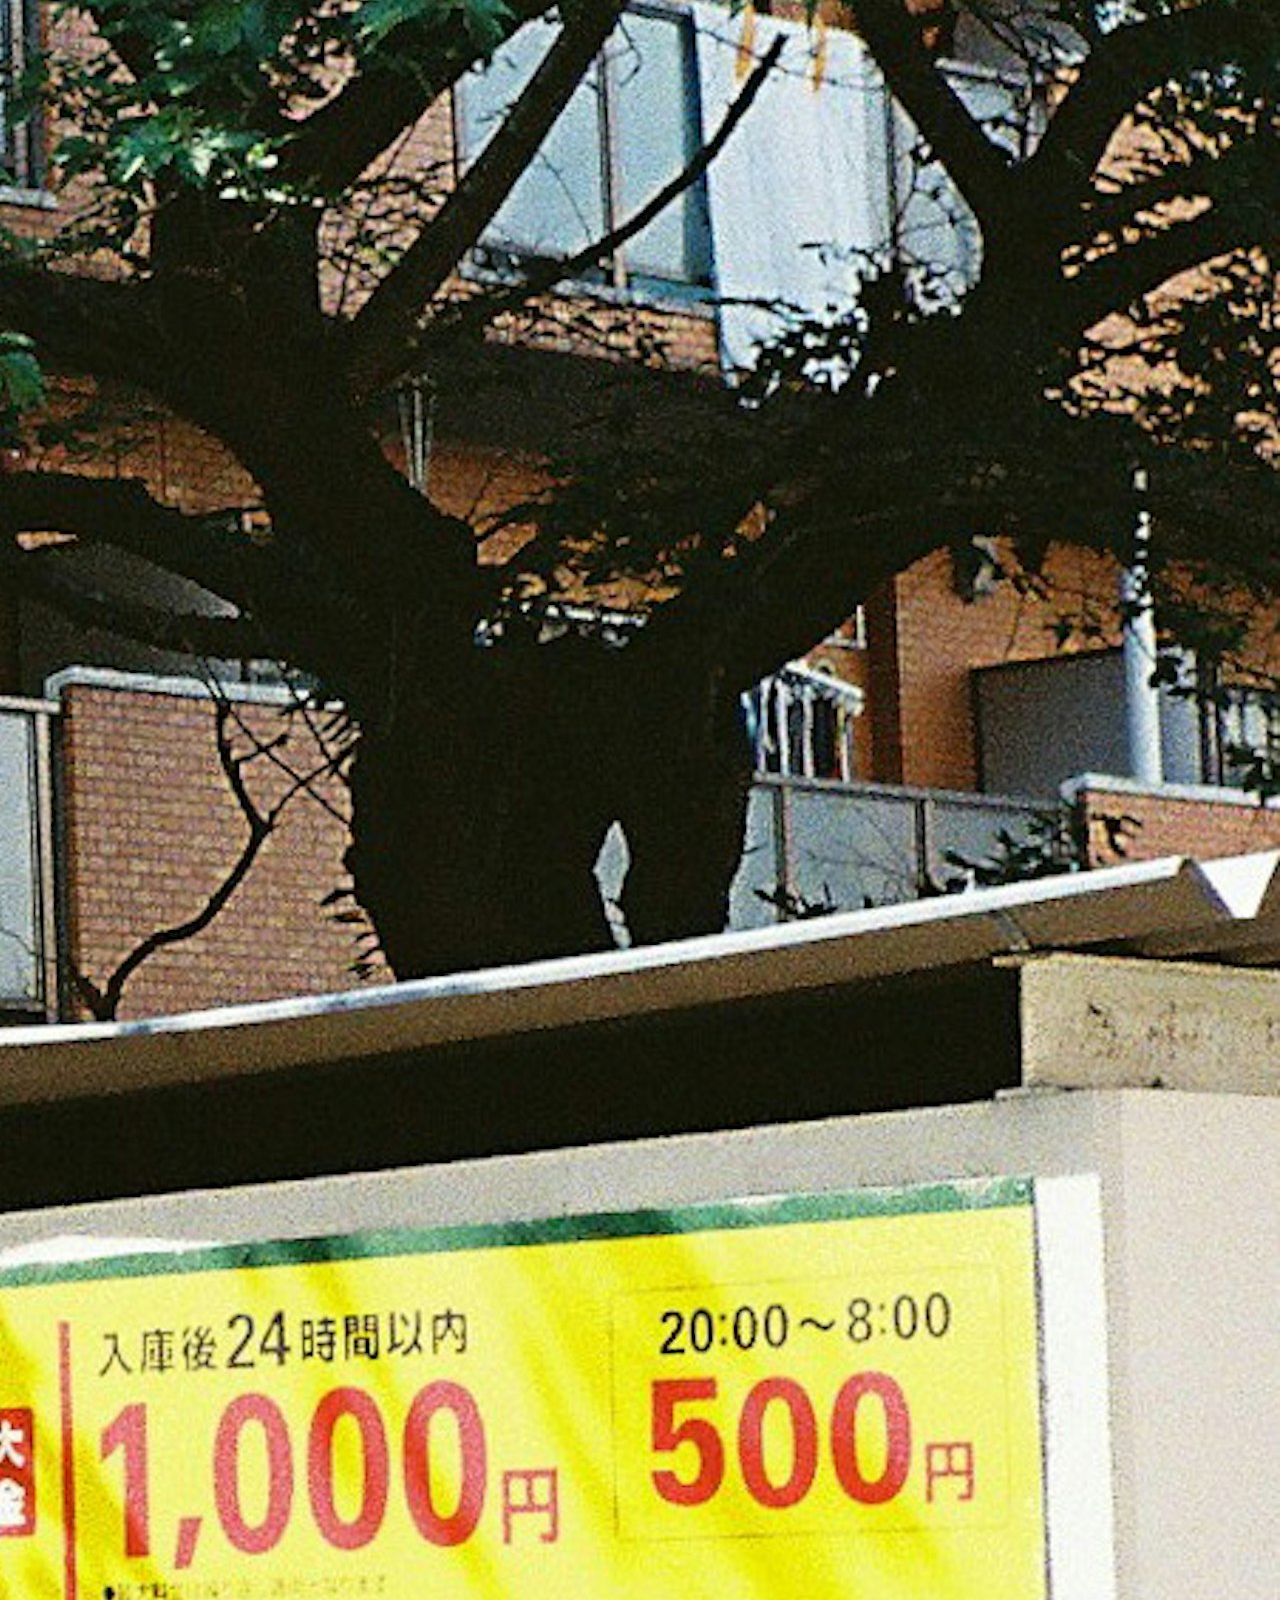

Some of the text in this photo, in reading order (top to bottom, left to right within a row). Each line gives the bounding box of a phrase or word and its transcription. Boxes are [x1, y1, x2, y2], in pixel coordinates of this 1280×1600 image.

[98, 1308, 469, 1378] 入庫後24時間以内
[99, 1379, 561, 1569] 1,000円
[650, 1370, 976, 1510] 500円
